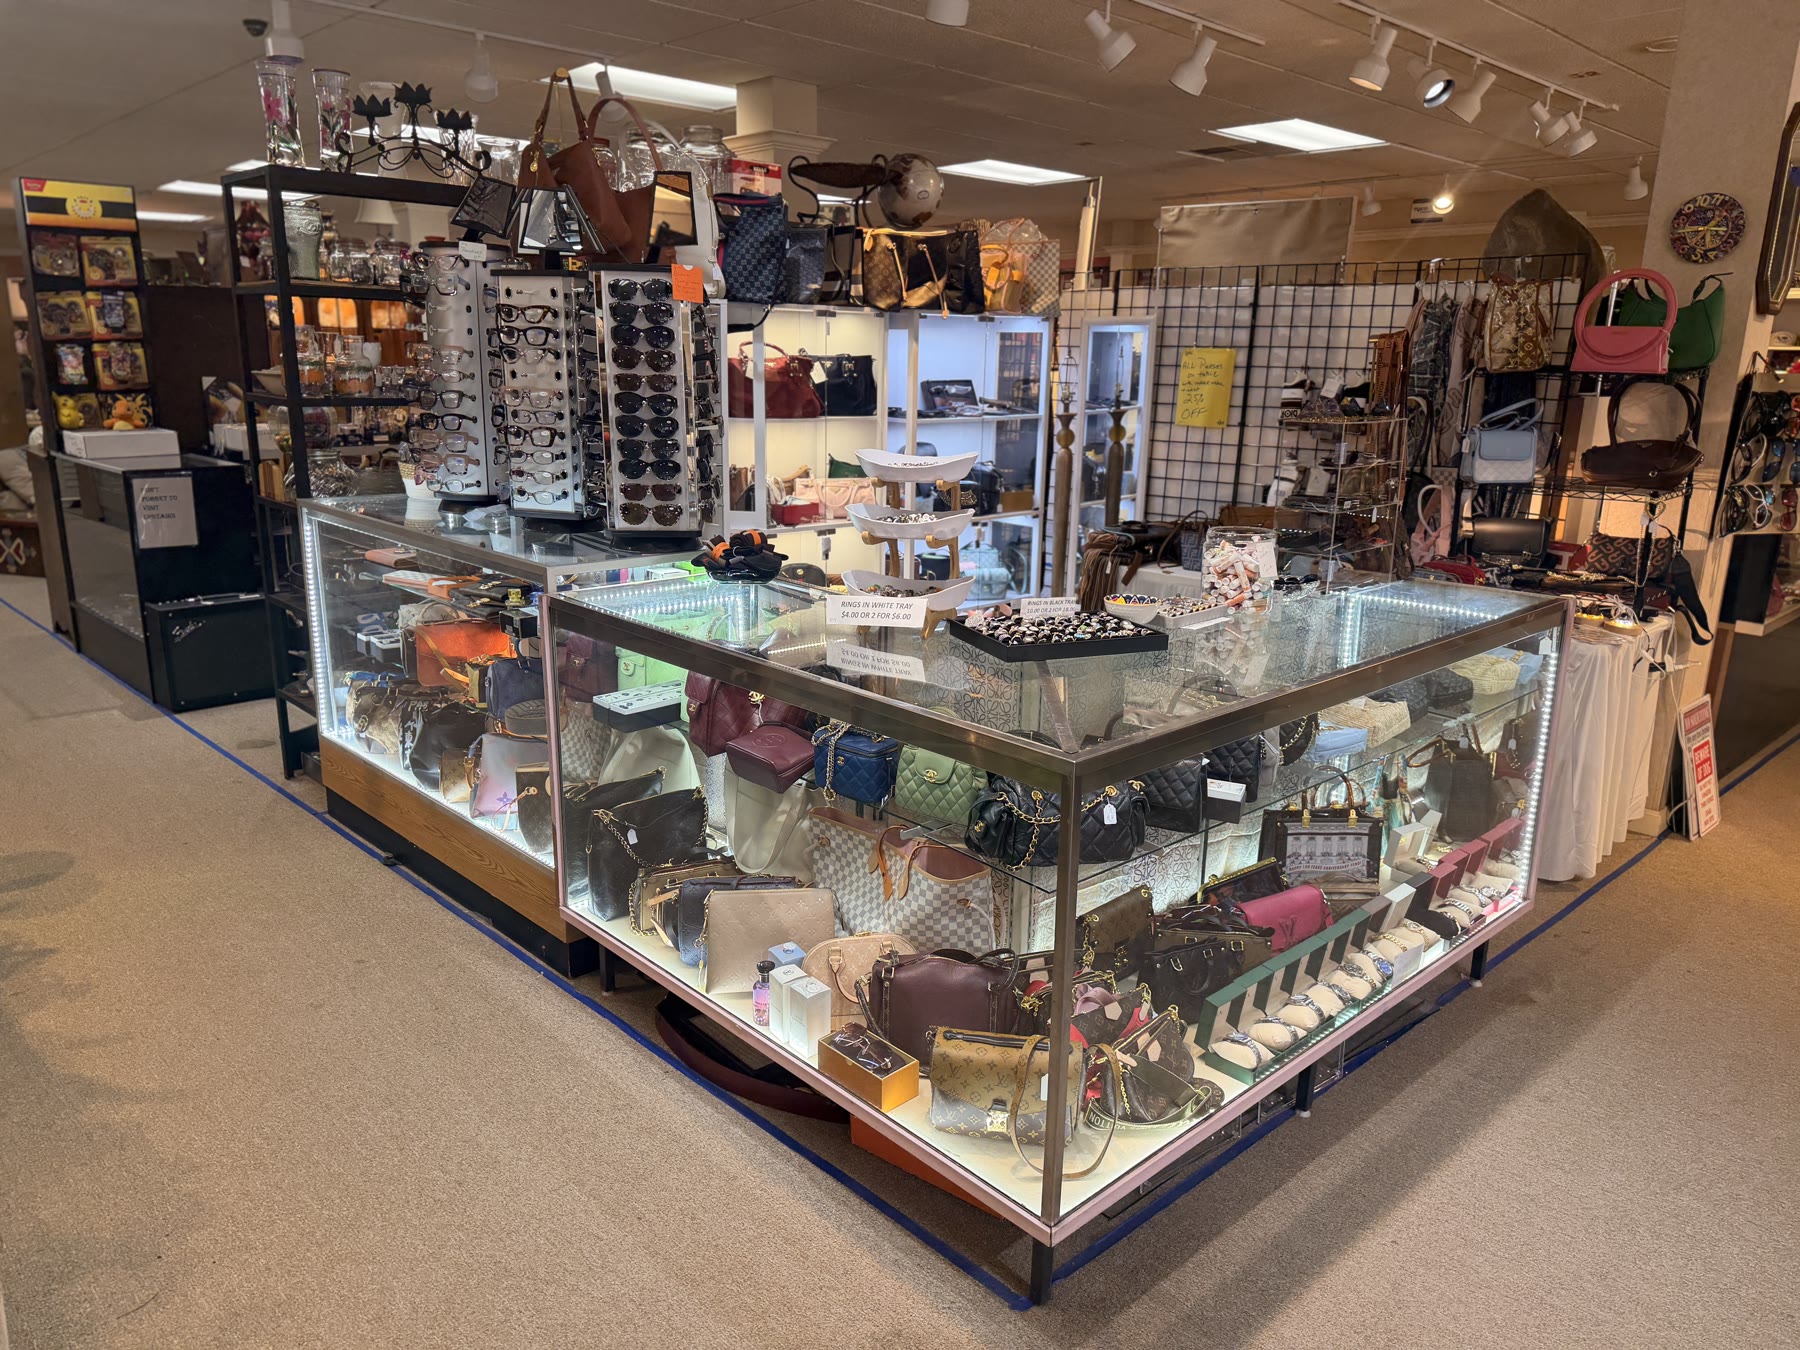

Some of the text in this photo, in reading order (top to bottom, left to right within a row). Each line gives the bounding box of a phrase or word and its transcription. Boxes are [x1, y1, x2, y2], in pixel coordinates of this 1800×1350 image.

[1695, 195, 1710, 207] 10
[1711, 194, 1724, 206] 11
[1183, 393, 1205, 405] 25%
[1181, 406, 1209, 419] OFF
[841, 611, 860, 619] $4.00
[892, 612, 912, 621] $6.00
